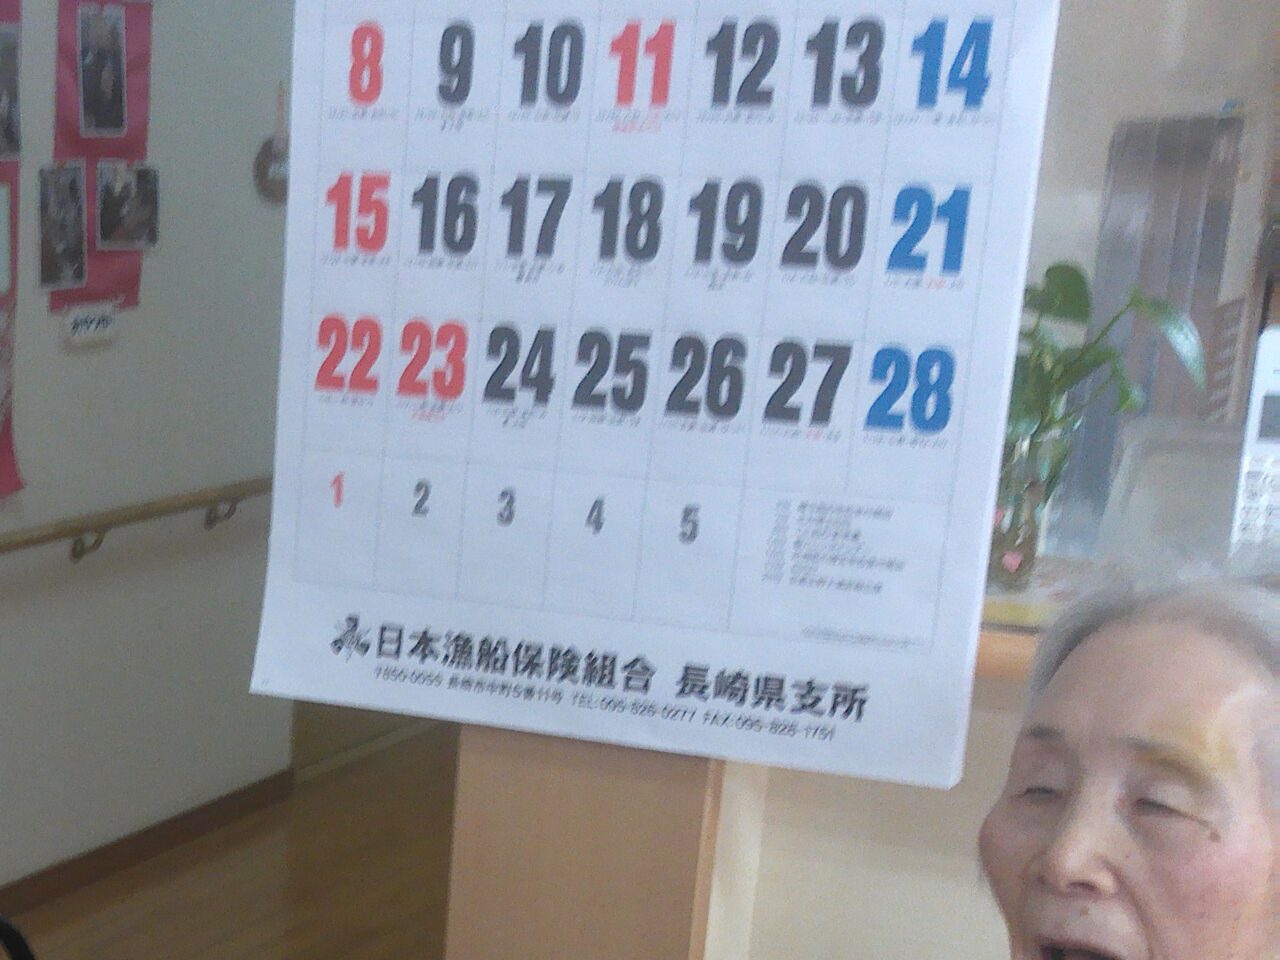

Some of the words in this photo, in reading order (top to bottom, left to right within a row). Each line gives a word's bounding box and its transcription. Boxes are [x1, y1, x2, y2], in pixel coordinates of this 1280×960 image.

[349, 22, 385, 107] 8
[438, 20, 477, 110] 9
[514, 21, 587, 110] 10
[610, 22, 677, 108] 11
[705, 17, 782, 111] 12
[805, 16, 887, 114] 13
[911, 16, 996, 113] 14
[326, 173, 392, 254] 15
[412, 172, 481, 259] 16
[501, 175, 575, 261] 17
[592, 176, 666, 266] 18
[688, 178, 766, 271] 19
[780, 179, 870, 272] 20
[886, 182, 974, 278] 21
[316, 315, 384, 395] 22
[398, 320, 470, 405] 23
[483, 322, 557, 409] 24
[571, 326, 653, 418] 25
[664, 332, 750, 424] 26
[762, 336, 855, 430] 27
[863, 343, 960, 438] 28
[331, 471, 345, 508] 1
[412, 479, 432, 517] 2
[497, 487, 516, 527] 3
[585, 496, 605, 534] 4
[680, 506, 700, 543] 5
[376, 622, 658, 695] 日本漁船保険組合
[674, 662, 871, 724] 長崎県支所
